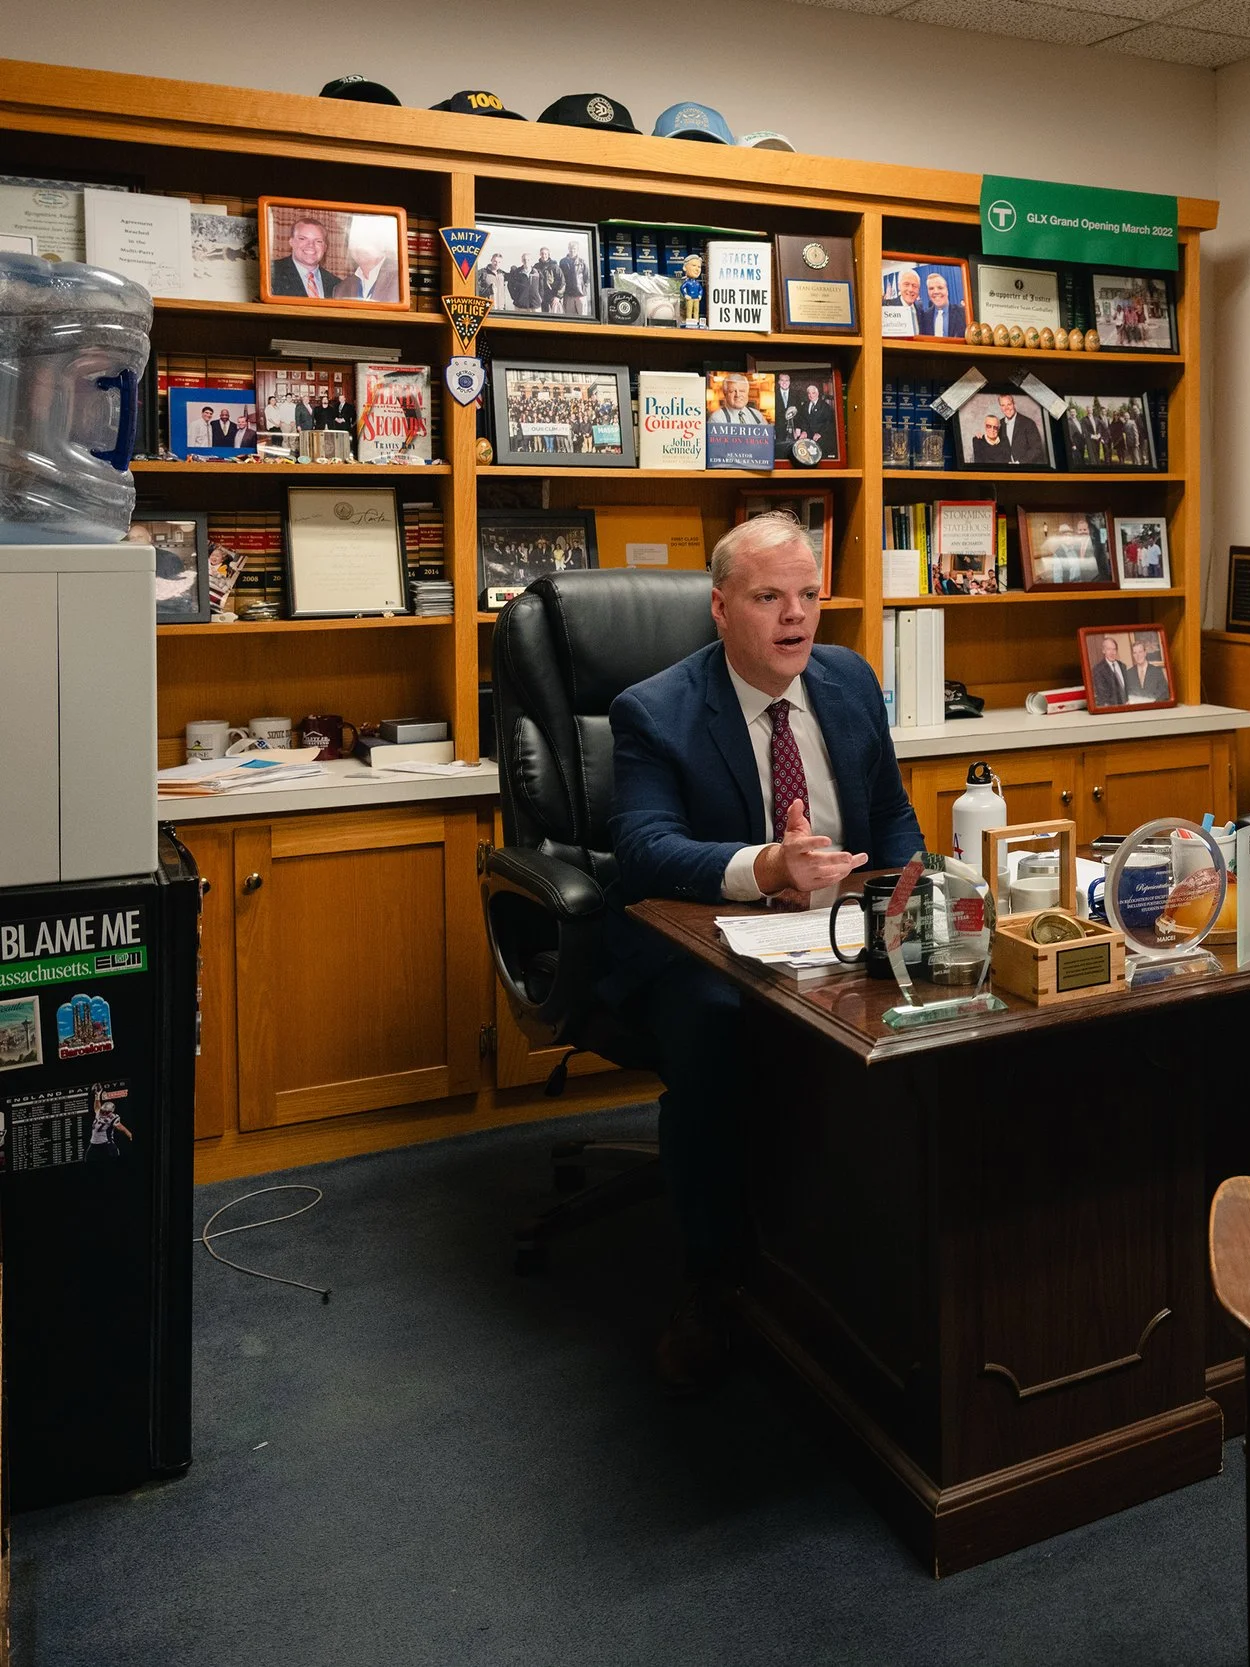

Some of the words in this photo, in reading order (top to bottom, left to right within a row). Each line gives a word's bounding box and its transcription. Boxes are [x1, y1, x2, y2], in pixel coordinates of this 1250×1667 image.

[468, 93, 503, 110] 100
[121, 219, 153, 227] Agreement
[993, 208, 1012, 227] T
[1027, 213, 1048, 224] GLX
[1050, 216, 1079, 228] Grand
[1081, 219, 1120, 234] Opening
[1122, 224, 1150, 235] March
[1152, 226, 1173, 237] 2022
[124, 228, 150, 236] Reached
[451, 232, 481, 243] AMITY
[451, 245, 481, 256] POLICE
[722, 253, 759, 266] STACEY
[719, 268, 761, 281] ABRAMS
[451, 298, 486, 306] HAWKINS
[713, 288, 736, 304] OUR
[739, 289, 768, 306] TIME
[989, 290, 1021, 300] Supporter
[1030, 294, 1051, 303] Justice
[451, 304, 485, 317] POLICE
[720, 308, 731, 323] IS
[735, 308, 762, 324] NOW
[645, 397, 701, 416] Profiles
[645, 415, 701, 439] Courage
[711, 426, 769, 437] AMERICA
[374, 441, 399, 450] TRAVIS
[671, 438, 691, 447] John
[663, 446, 701, 459] Kennedy
[944, 511, 991, 520] STORMING
[944, 524, 990, 532] STATEHOUSE
[1, 916, 96, 961] BLAME
[100, 910, 141, 948] ME
[0, 961, 92, 988] assachusetts.
[61, 1042, 113, 1059] Barcelona
[6, 1091, 62, 1104] ENGLAND
